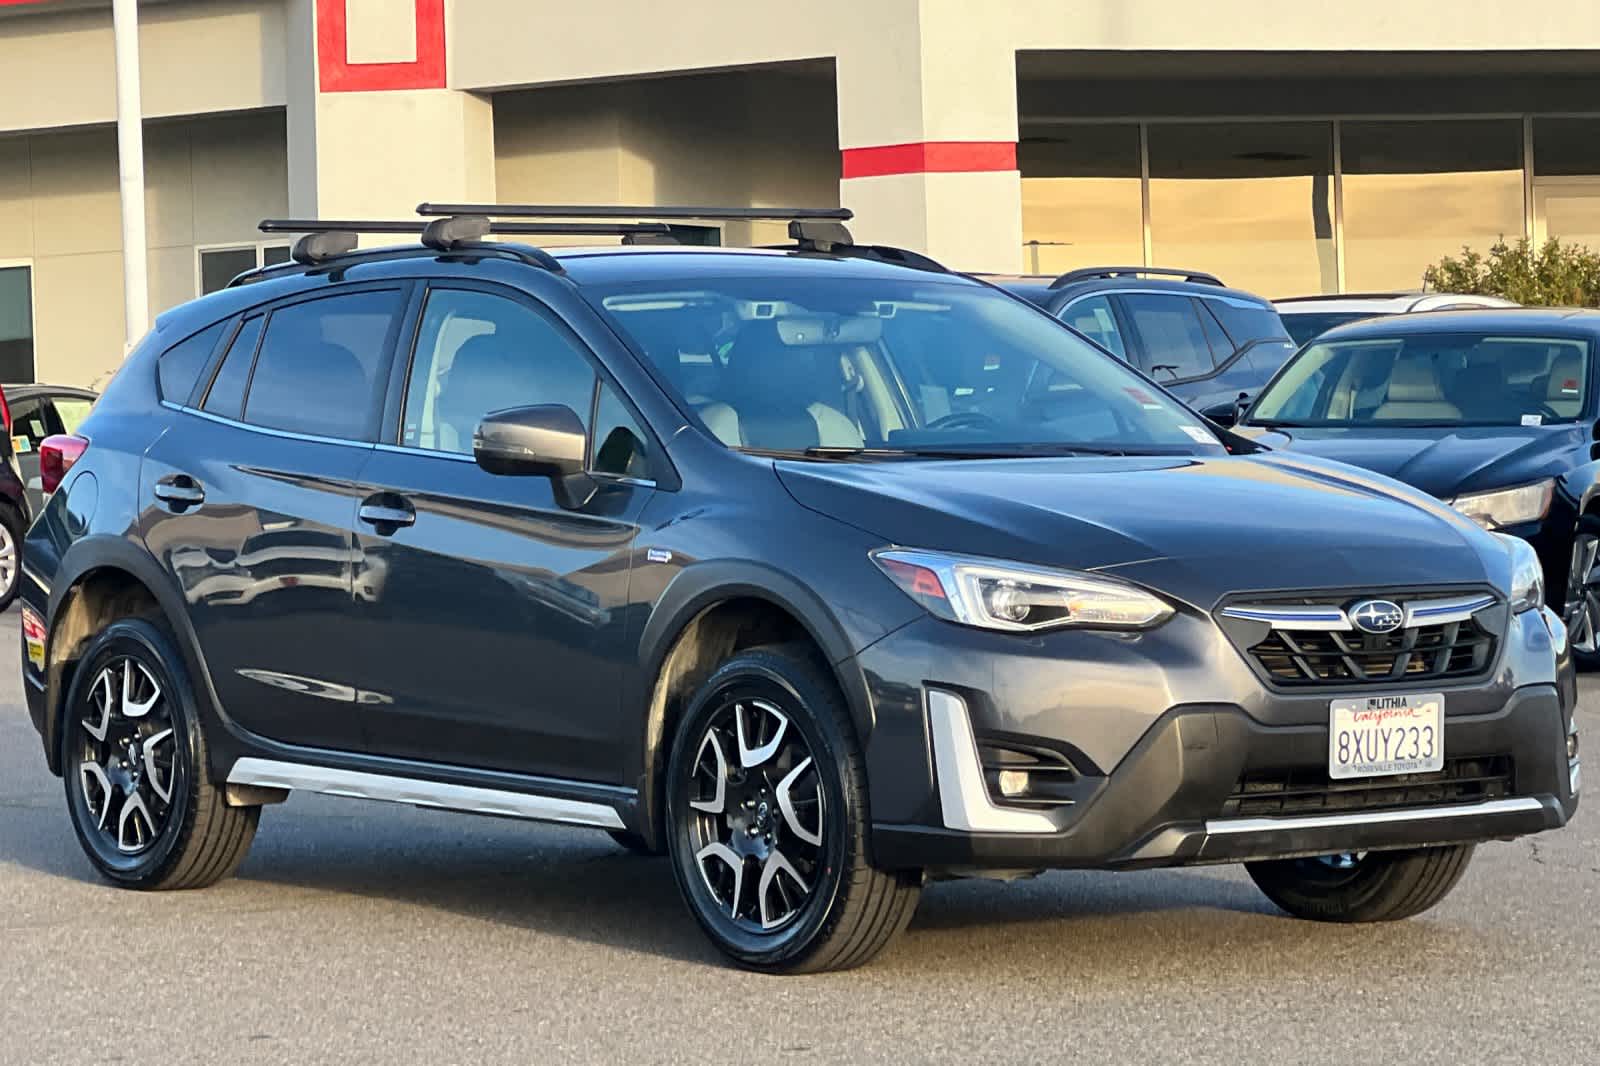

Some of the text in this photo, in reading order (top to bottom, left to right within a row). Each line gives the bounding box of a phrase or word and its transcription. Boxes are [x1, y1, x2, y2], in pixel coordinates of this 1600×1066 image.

[1376, 697, 1407, 709] LITHIA
[1353, 708, 1420, 726] California
[1338, 725, 1434, 764] 8XUY233
